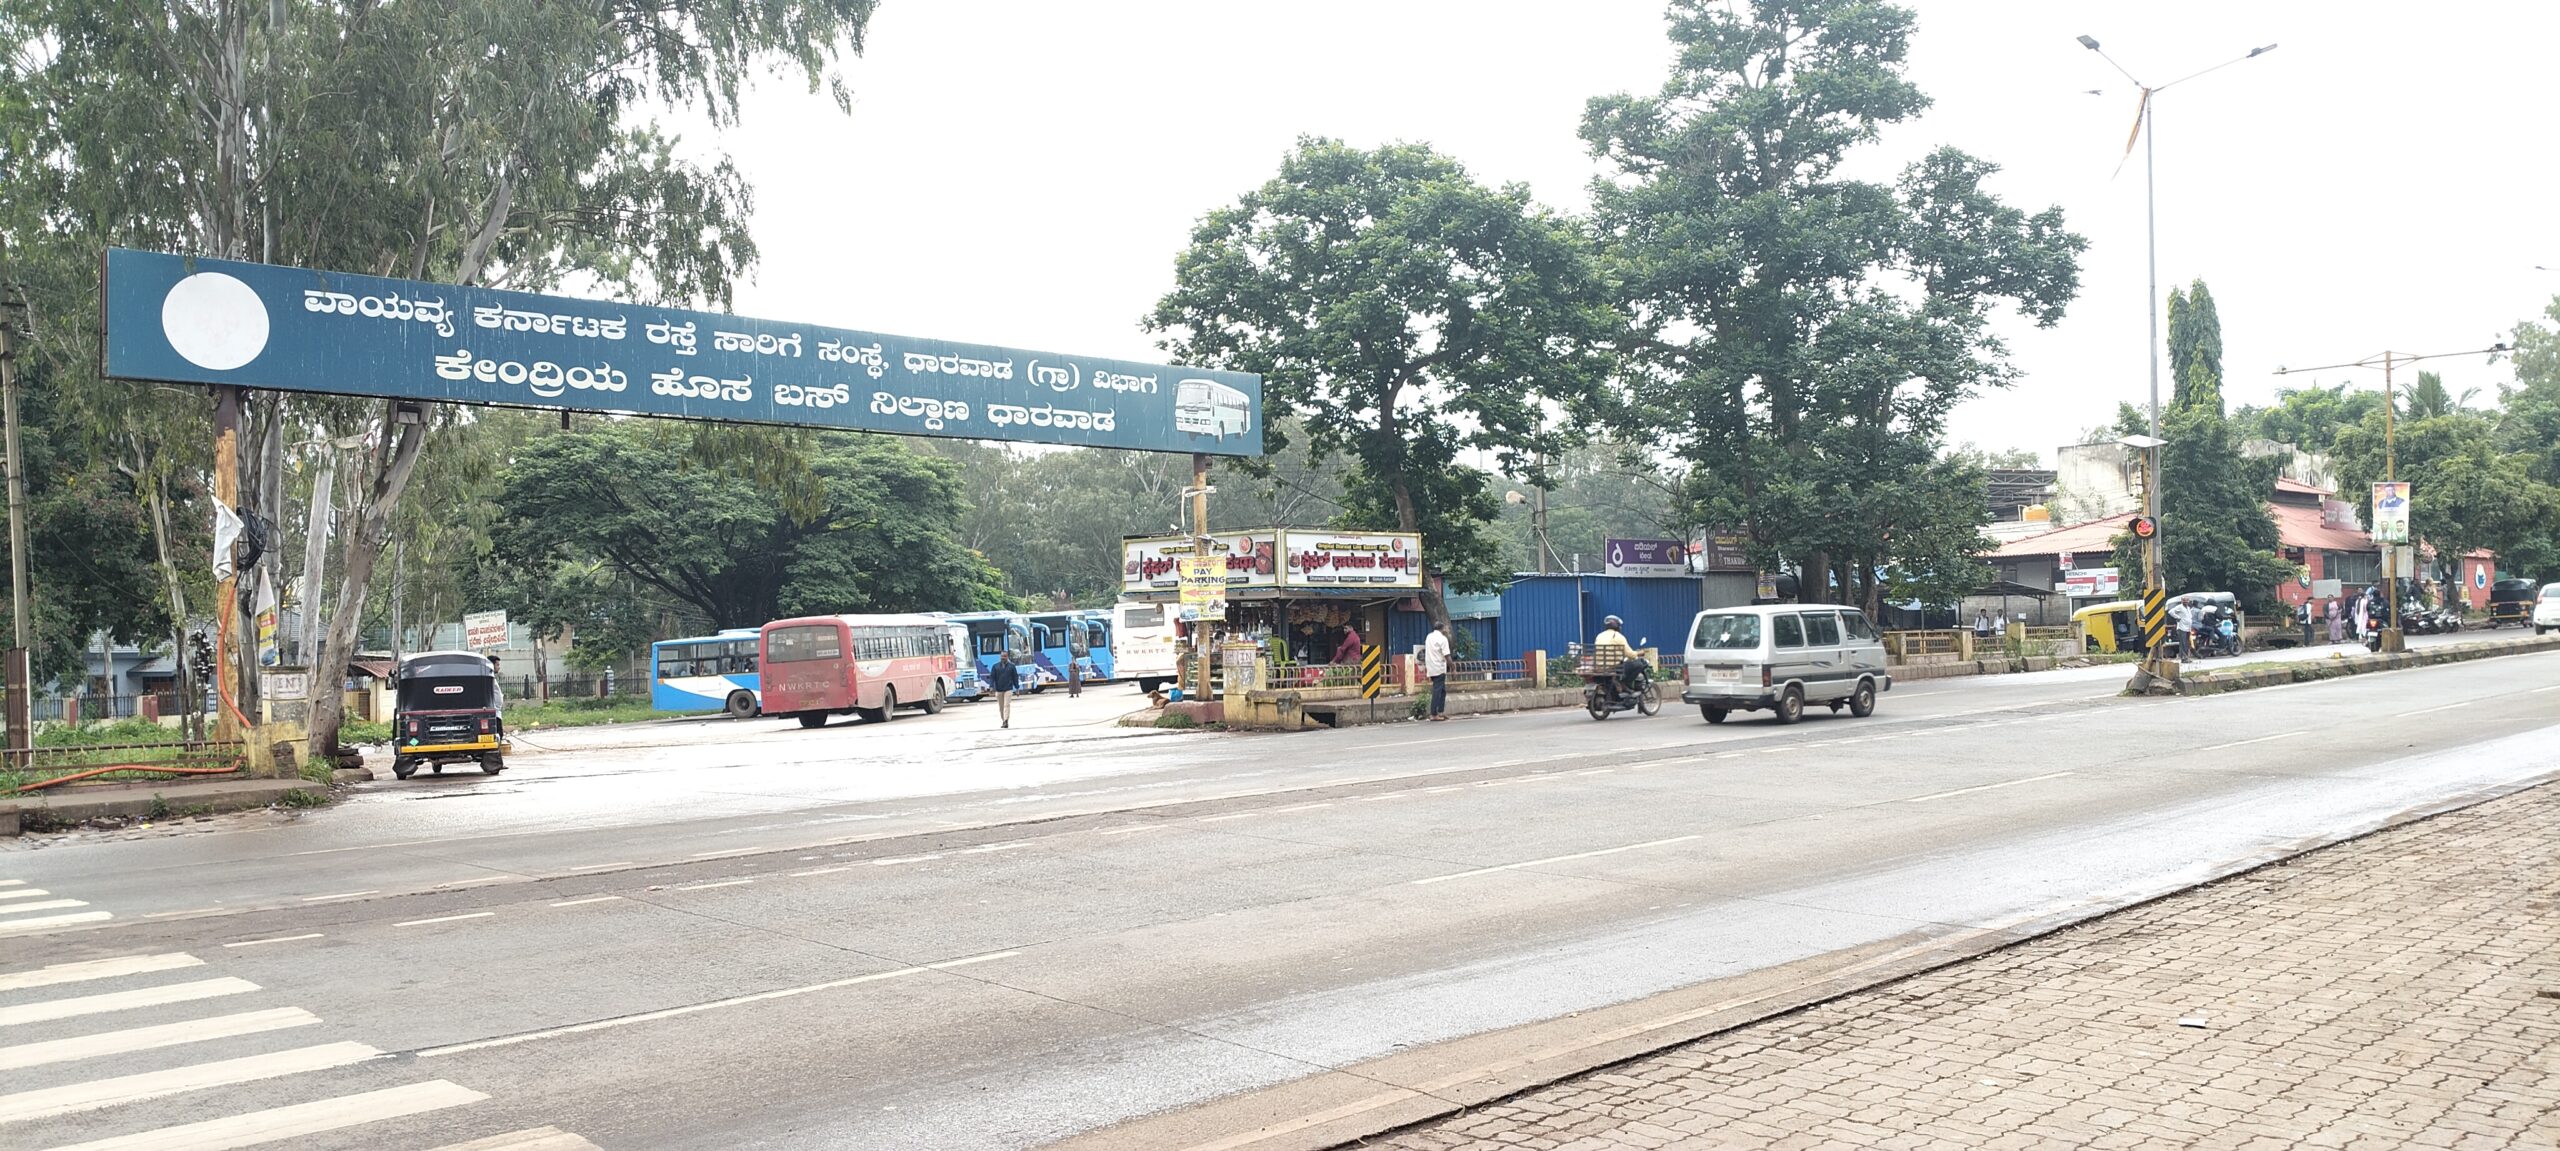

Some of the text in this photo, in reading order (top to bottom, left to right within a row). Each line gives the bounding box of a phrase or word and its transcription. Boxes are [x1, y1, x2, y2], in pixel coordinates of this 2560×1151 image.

[304, 290, 1158, 394] ವಾಯವ್ಯ ಕರ್ನಾಟಕ ರಸ್ತೆ ಸಾರಿಗೆ ಸಂಸ್ಥೆ, ಧಾರವಾಡ (ಗ್ರಾ) ವಿಭಾಗ
[435, 349, 1116, 432] ಕೇಂದ್ರಿಯ ಹೊಸ ಬಸ್ ನಿಲ್ದಾಣ ಧಾರವಾಡ
[778, 681, 830, 692] NWKRTC
